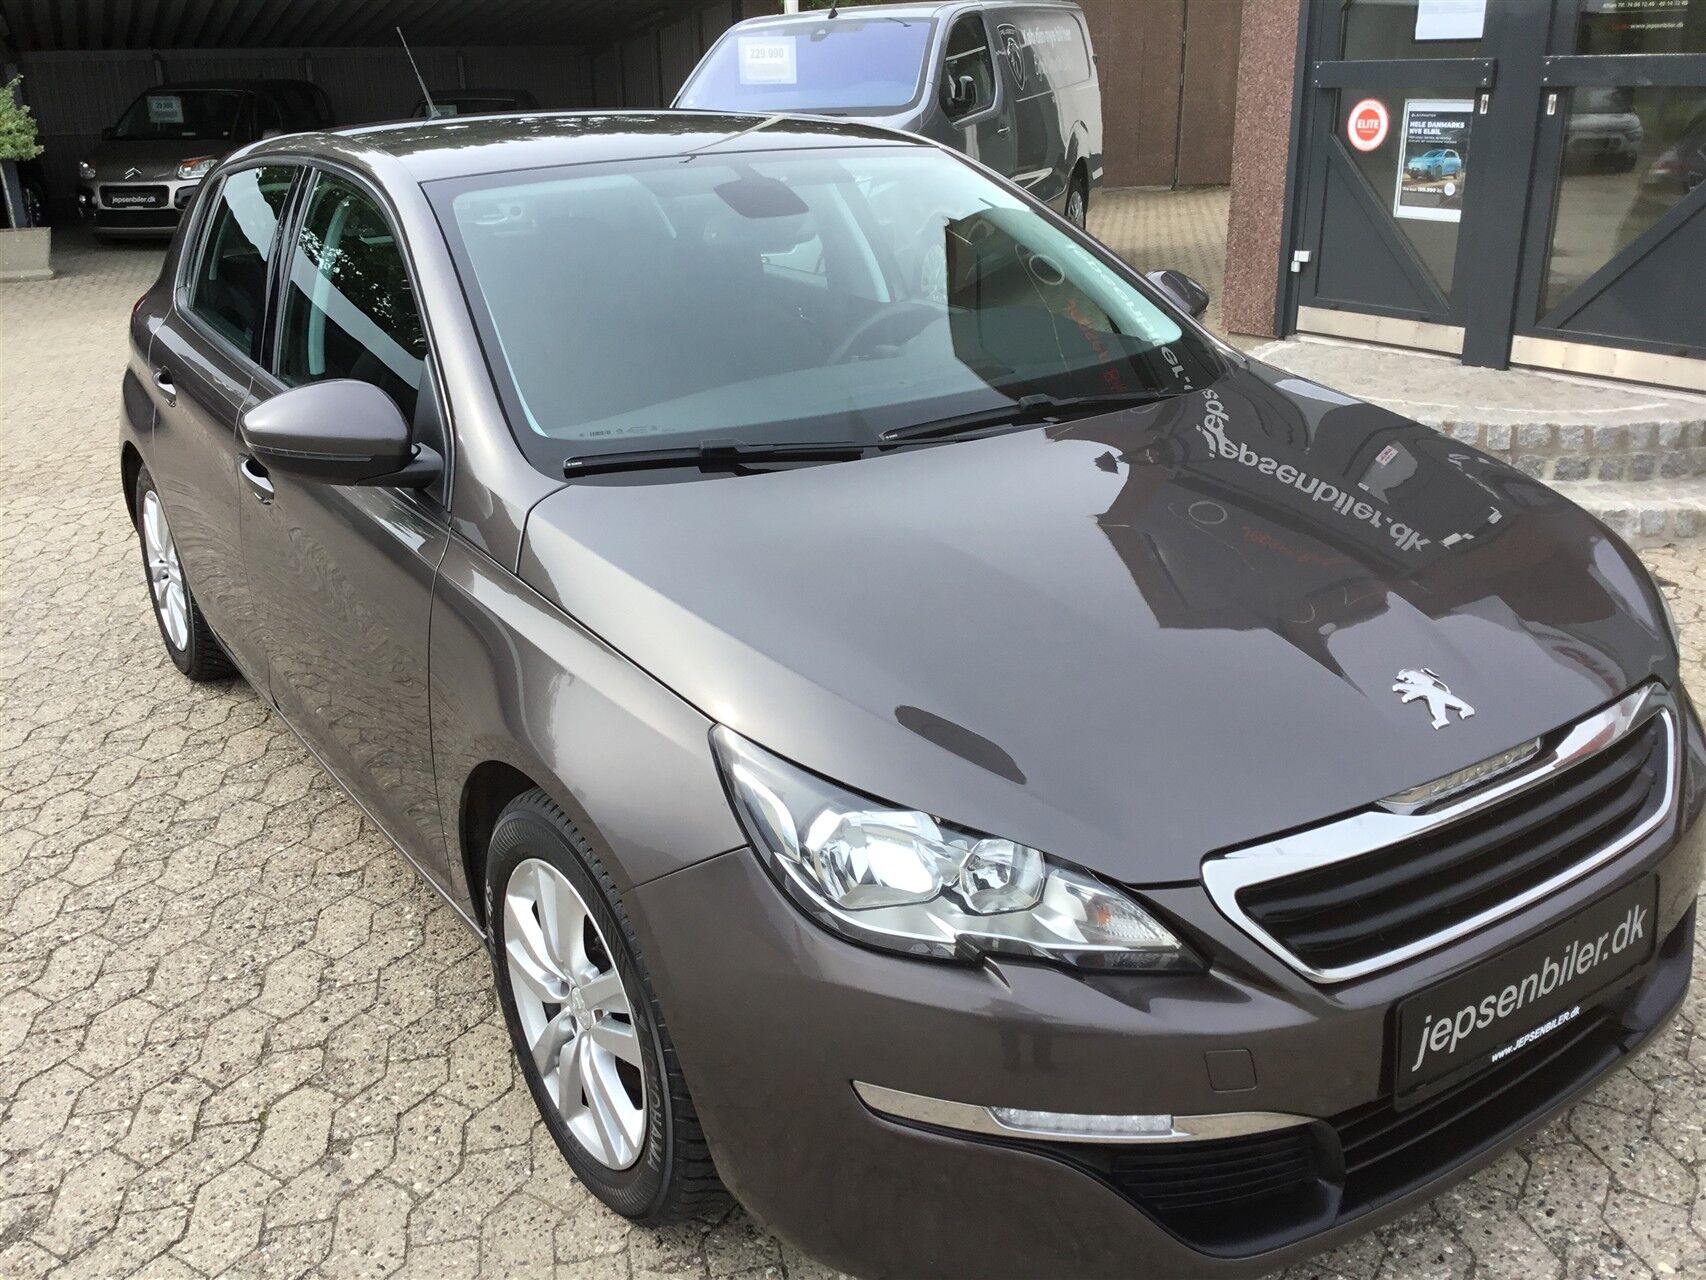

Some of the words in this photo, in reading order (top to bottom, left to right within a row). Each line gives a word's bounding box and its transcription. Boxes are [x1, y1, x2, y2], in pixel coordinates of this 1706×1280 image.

[750, 48, 784, 59] 229.990
[1357, 118, 1380, 128] ELITE
[1427, 121, 1465, 129] DANMARKS
[1411, 904, 1648, 1072] jepsenbiler.dk
[1491, 1005, 1581, 1063] www.JEPSENBILER.dk
